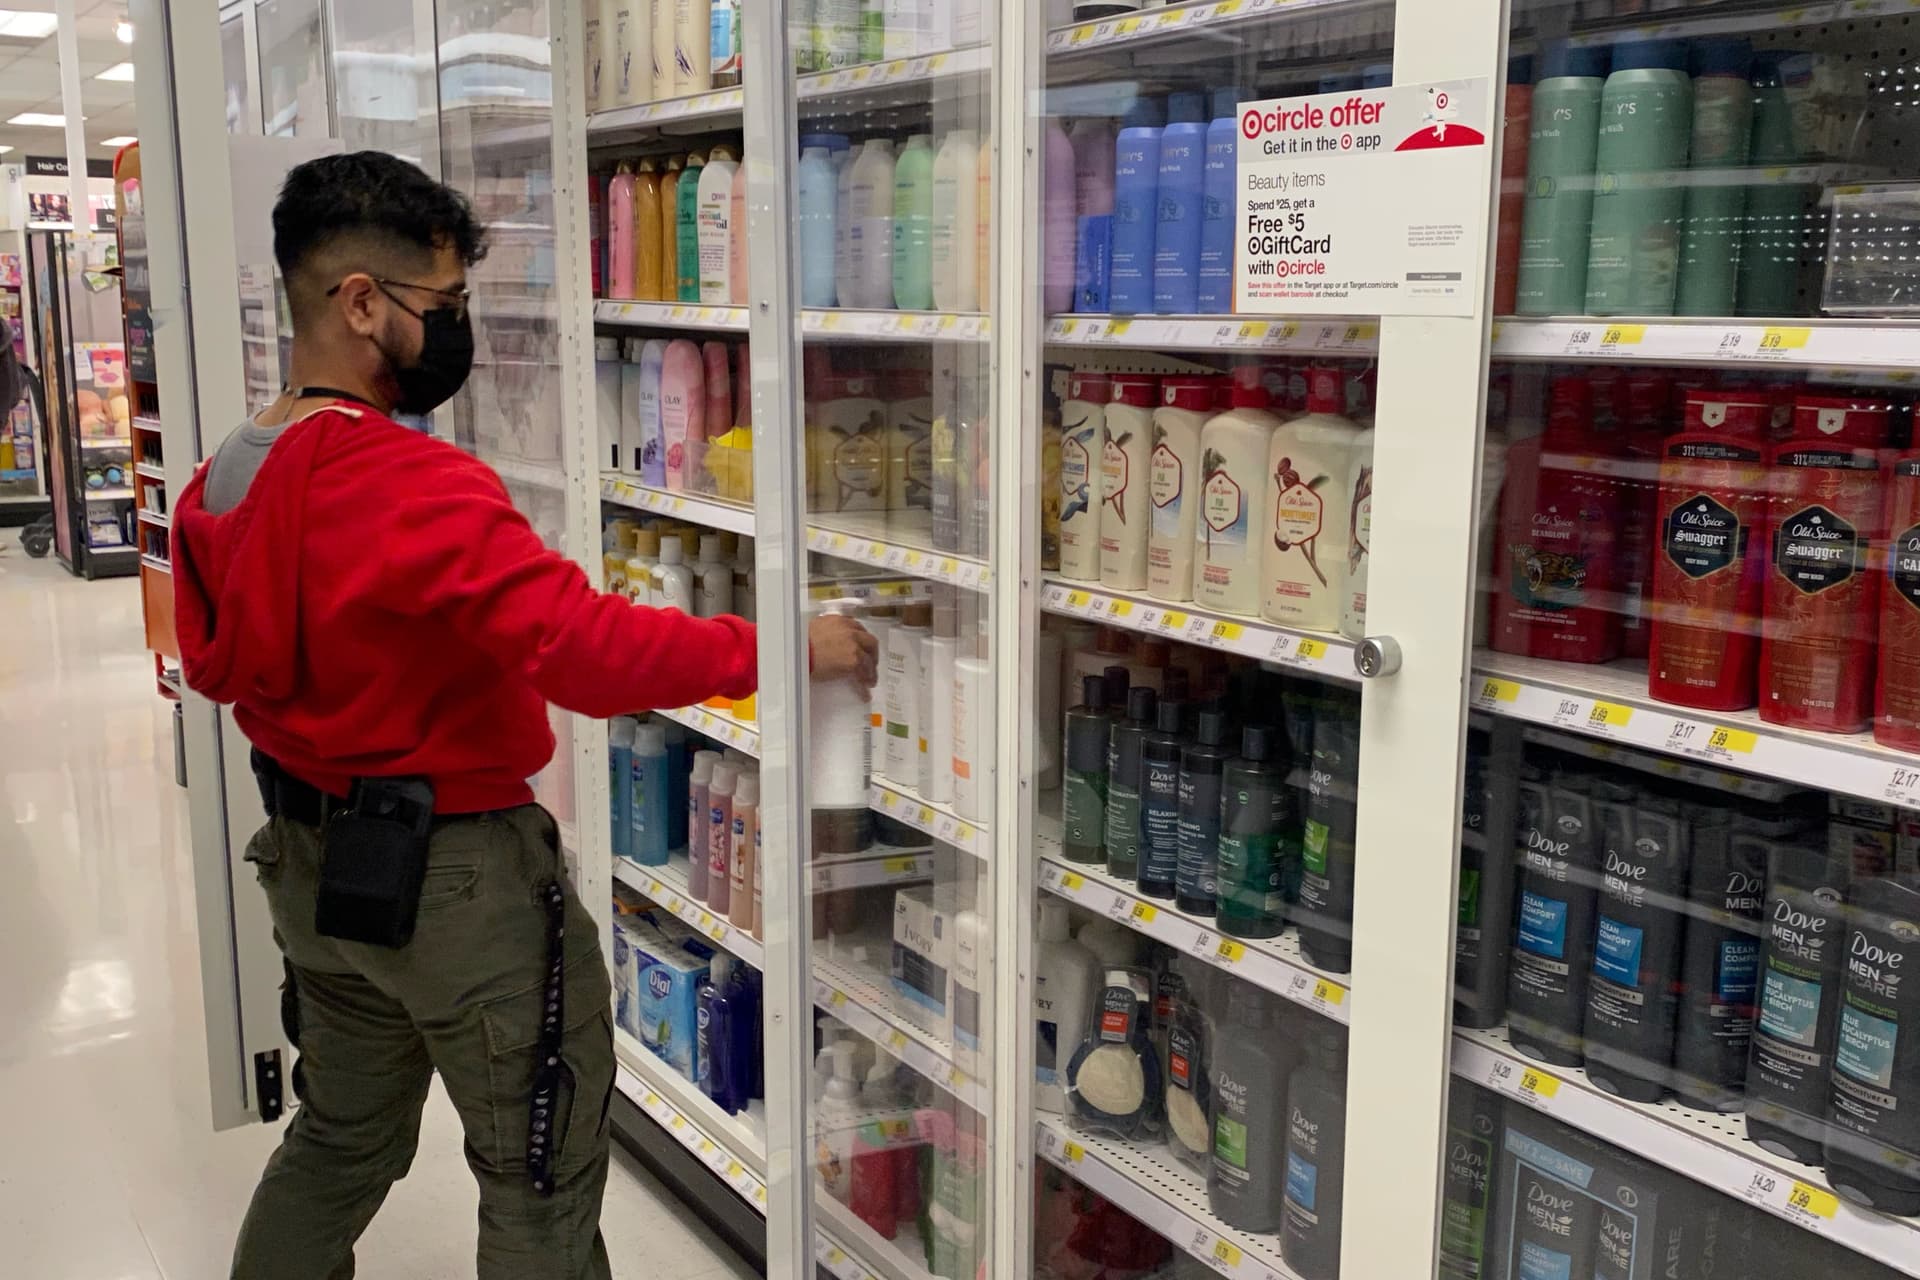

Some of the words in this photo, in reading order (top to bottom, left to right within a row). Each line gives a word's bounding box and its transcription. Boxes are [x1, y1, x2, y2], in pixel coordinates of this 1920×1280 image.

[1263, 102, 1324, 133] circle
[1329, 97, 1386, 128] offer
[1263, 138, 1286, 155] Get
[1289, 138, 1298, 153] it
[1301, 137, 1313, 152] in
[1316, 136, 1337, 151] the
[1356, 134, 1382, 151] app
[37, 162, 56, 171] Hair
[1248, 173, 1290, 192] Beauty
[1292, 171, 1326, 188] items
[1248, 199, 1275, 213] Spend
[1276, 198, 1291, 211] $25,
[1293, 198, 1308, 211] get
[1309, 199, 1315, 208] a
[1248, 215, 1283, 234] Free
[1288, 213, 1305, 232] $5
[1261, 234, 1331, 255] GiftCard
[1248, 259, 1274, 275] with
[1289, 259, 1326, 276] circle
[1273, 281, 1286, 289] offer
[1304, 281, 1322, 290] Target
[1323, 282, 1334, 290] app
[1349, 281, 1399, 290] Target.com/circle
[1531, 512, 1550, 525] Old
[1549, 514, 1575, 527] Spice
[1680, 511, 1699, 524] Old
[1698, 513, 1726, 527] Spice
[1674, 529, 1728, 547] Swagger
[1791, 523, 1811, 537] Old
[1811, 526, 1843, 541] Spice
[1784, 543, 1844, 561] Swagger
[1557, 701, 1580, 716] 10.33
[1671, 722, 1696, 739] 12.17
[1709, 730, 1729, 746] 7.99
[1150, 768, 1176, 781] Dove
[1891, 769, 1920, 788] 12.17
[1148, 808, 1177, 817] RELAXIN
[1527, 827, 1570, 857] Dove
[1526, 851, 1552, 869] MEN
[1606, 849, 1647, 881] Dove
[1604, 873, 1628, 893] MEN
[1726, 871, 1764, 897] Dov
[1523, 894, 1544, 909] CLEAN
[1725, 897, 1763, 910] MEN
[1522, 903, 1556, 921] COMFORT
[1773, 898, 1827, 933] Dove
[1600, 920, 1620, 934] CLEAN
[1771, 924, 1804, 946] MEN
[903, 923, 934, 953] IVORY
[1600, 929, 1632, 947] COMFORT
[1725, 945, 1755, 955] CLEAN
[1850, 930, 1904, 969] Dove
[1848, 957, 1880, 982] MEN
[650, 969, 672, 995] Dial
[1766, 975, 1784, 992] BLUE
[1105, 989, 1132, 1001] Dove
[1765, 986, 1815, 1010] EUCALYPTUS
[1769, 997, 1793, 1014] BIRCH
[1843, 1012, 1859, 1028] BLUE
[1842, 1021, 1891, 1050] EUCALYPTUS
[1845, 1035, 1869, 1052] BIRCH
[1219, 1071, 1248, 1096] Dove
[1521, 1073, 1538, 1090] 7.99
[1219, 1087, 1237, 1104] MEN
[1292, 1106, 1319, 1135] Dove
[1508, 1133, 1530, 1153] BUY
[1554, 1159, 1585, 1181] SAVE
[1450, 1162, 1480, 1179] MEN
[1527, 1180, 1575, 1213] Dove
[1752, 1174, 1776, 1193] 14.20
[1789, 1189, 1810, 1208] 7.99
[1527, 1202, 1557, 1223] MEN
[1601, 1211, 1632, 1246] Dove
